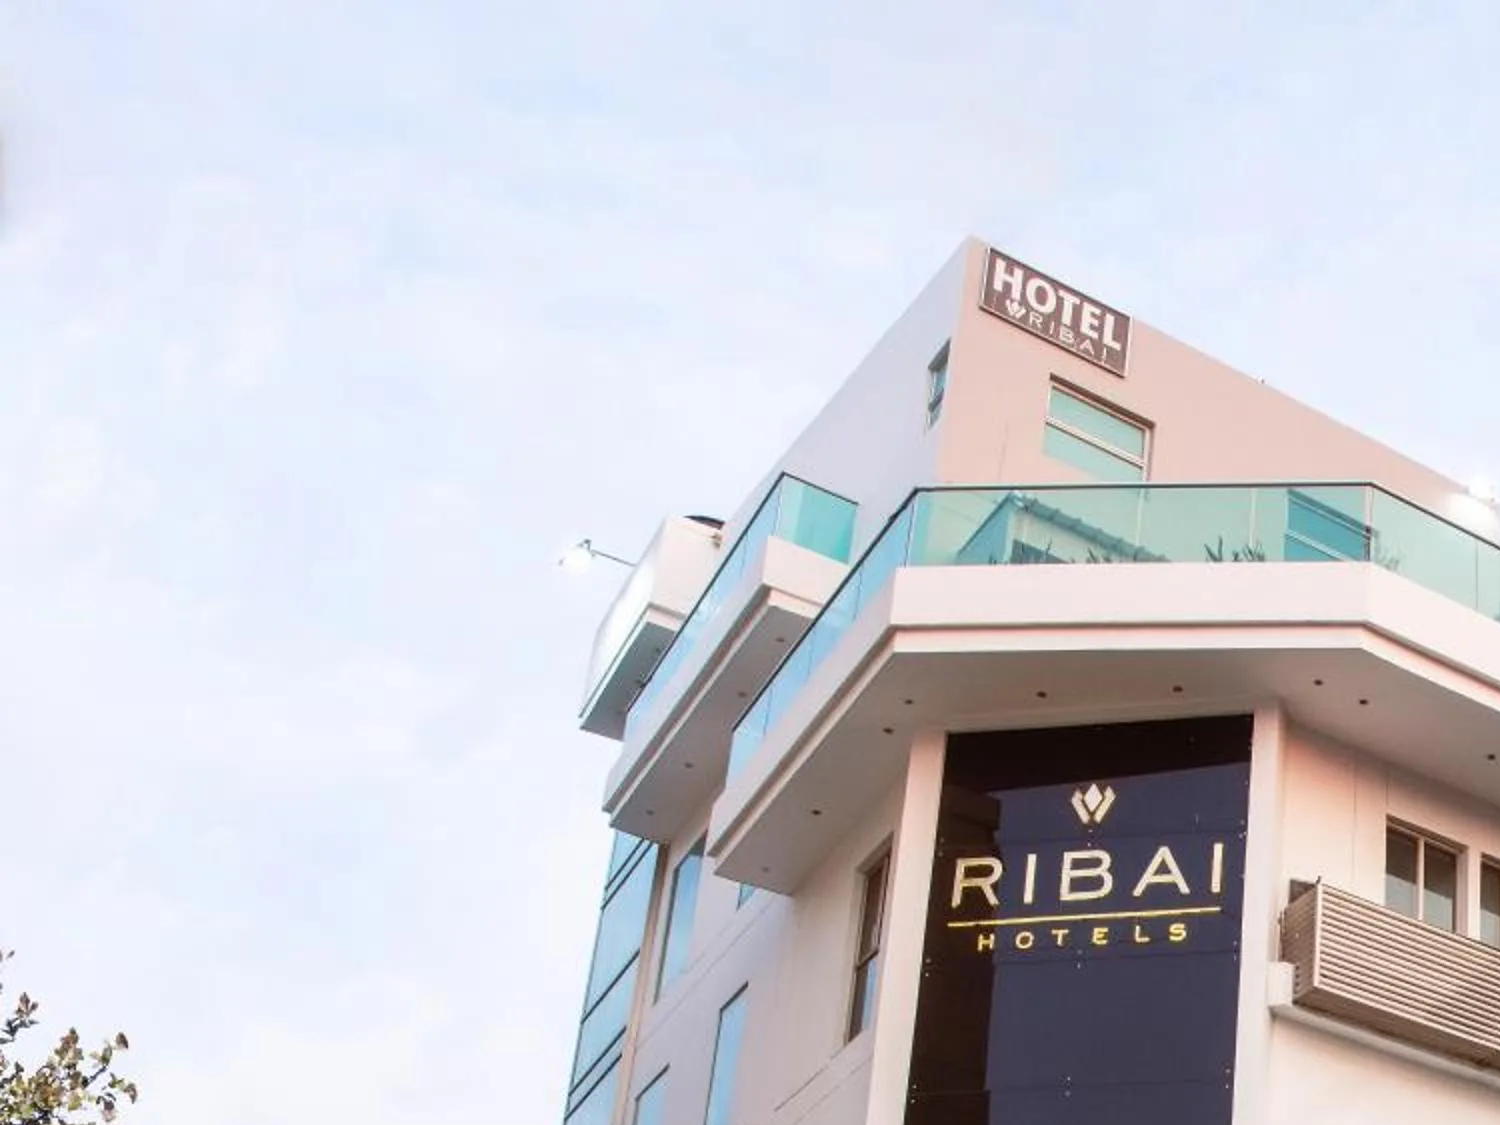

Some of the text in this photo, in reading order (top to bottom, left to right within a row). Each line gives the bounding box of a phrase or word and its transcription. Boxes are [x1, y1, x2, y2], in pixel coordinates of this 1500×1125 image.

[993, 256, 1122, 351] HOTEL
[1028, 311, 1108, 364] RIBAI
[951, 842, 1224, 909] RIBAI
[976, 922, 1188, 952] HOTELS
